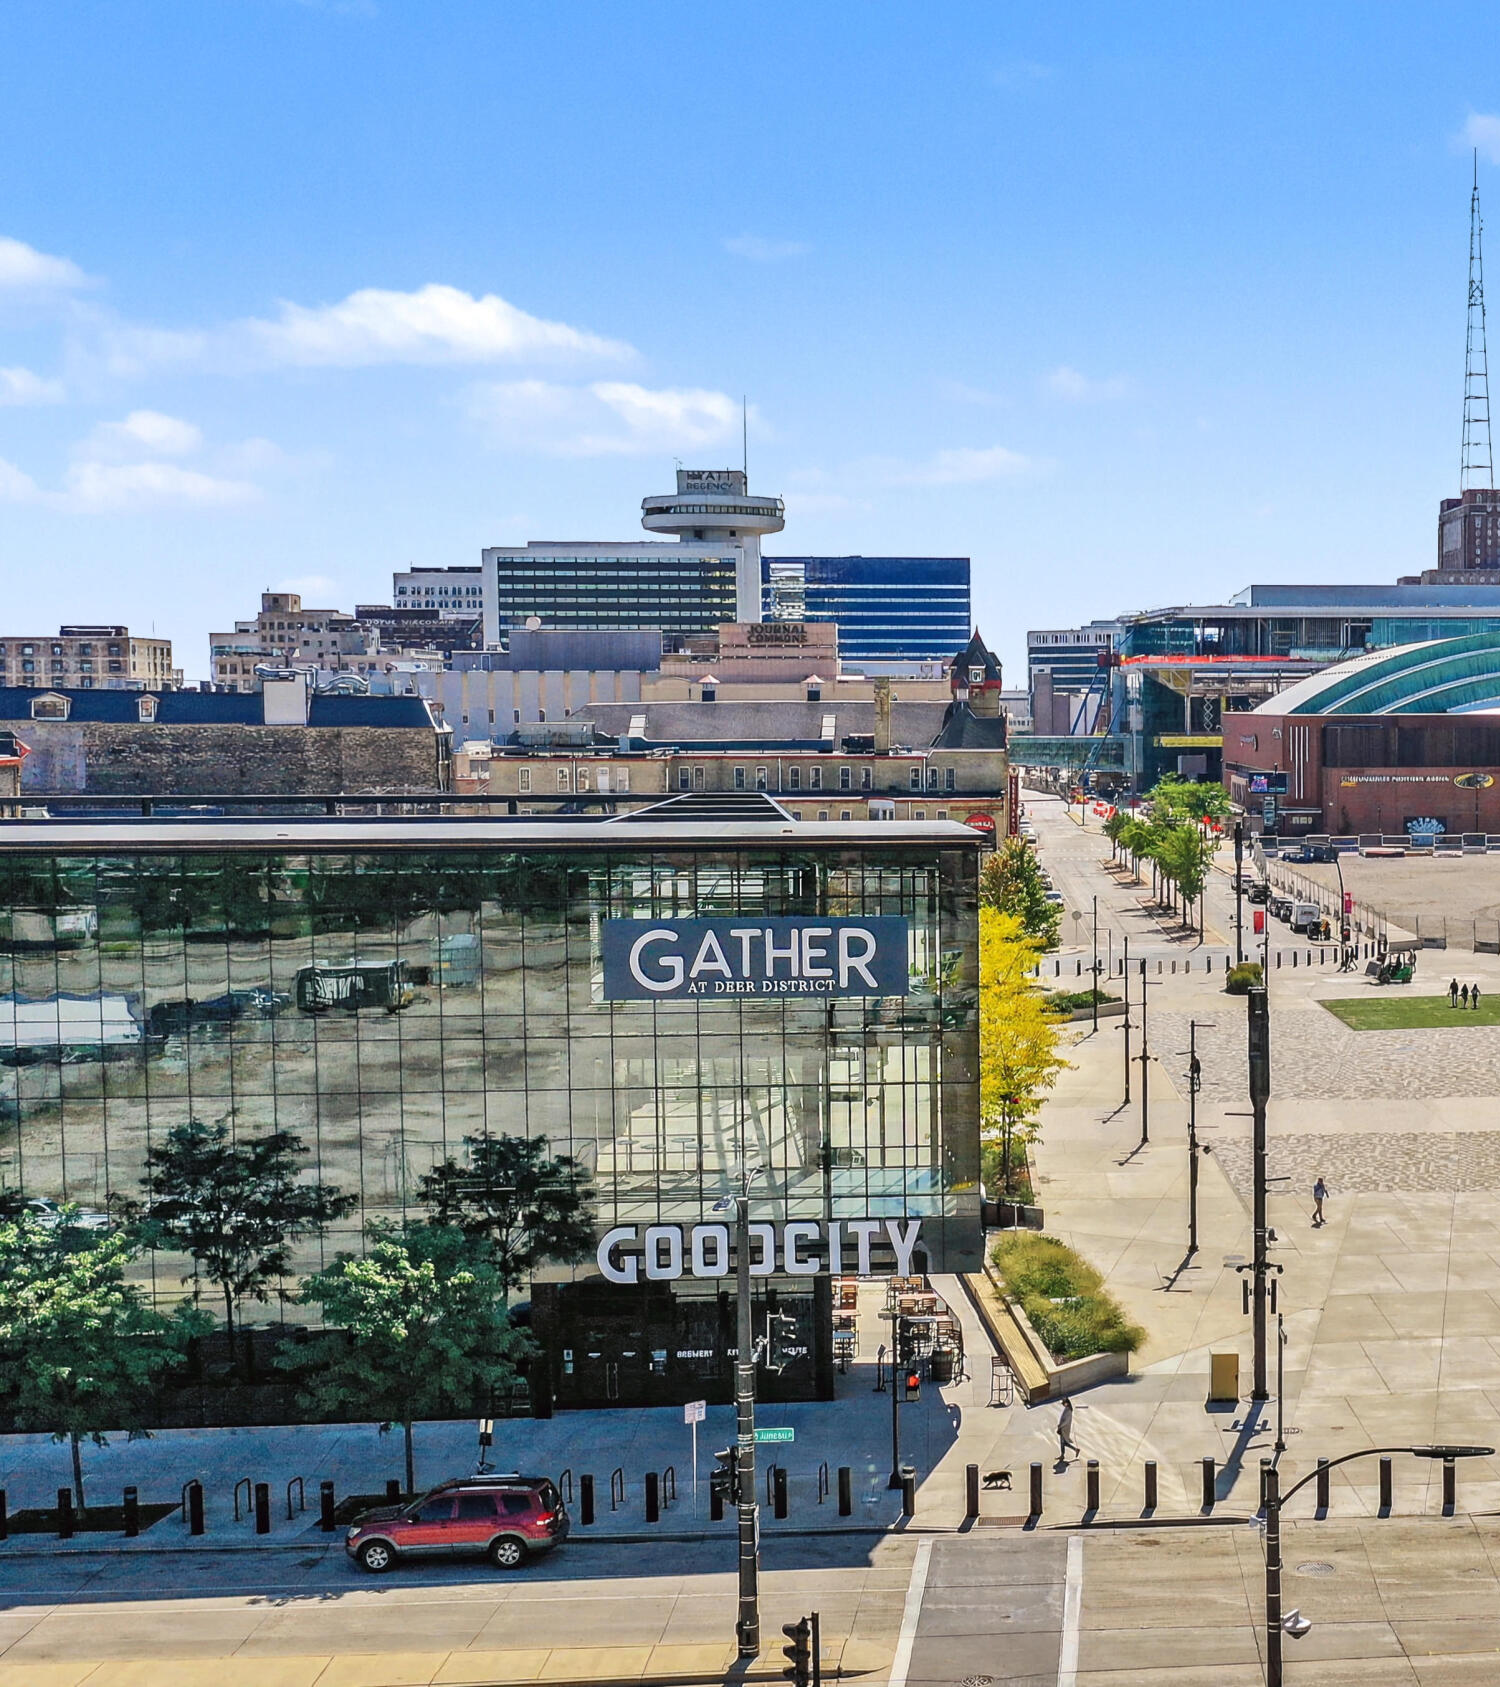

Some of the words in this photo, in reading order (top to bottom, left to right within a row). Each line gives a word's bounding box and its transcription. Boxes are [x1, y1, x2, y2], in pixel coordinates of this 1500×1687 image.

[747, 625, 807, 634] JOURNAL
[629, 927, 878, 992] GATHER
[687, 982, 708, 993] AT
[715, 981, 756, 993] DEER
[762, 980, 836, 992] DISTRICT
